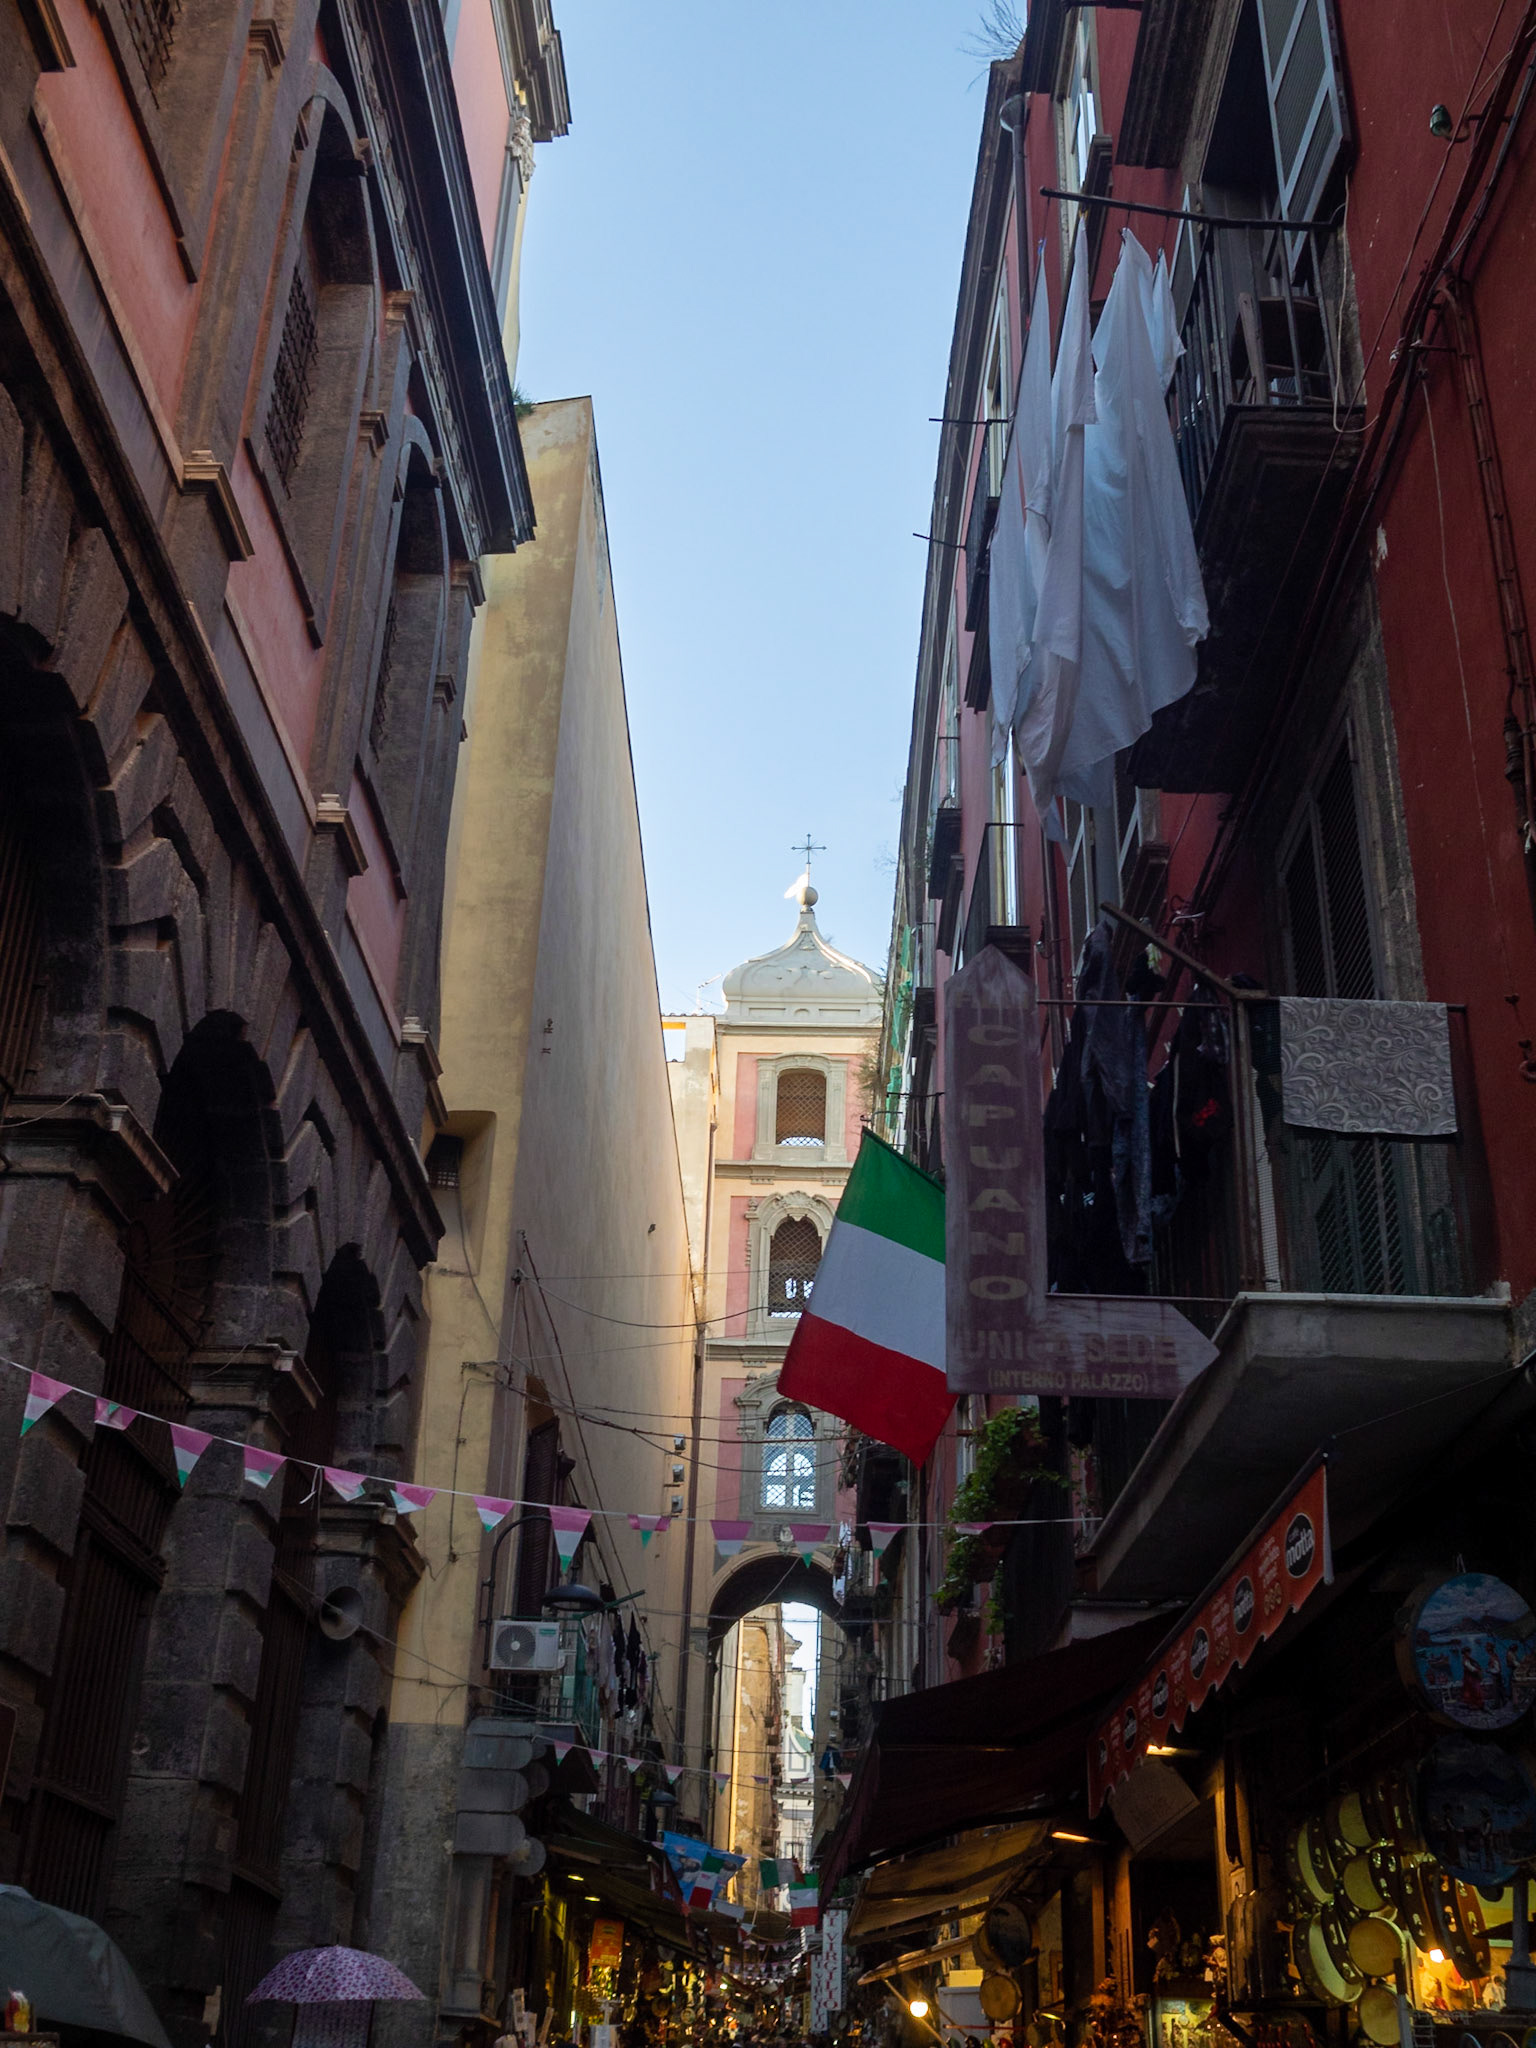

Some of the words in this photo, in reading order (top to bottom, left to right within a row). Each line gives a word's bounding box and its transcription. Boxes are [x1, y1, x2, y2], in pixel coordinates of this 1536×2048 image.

[966, 1025, 1029, 1300] CAPUANO
[1084, 1333, 1177, 1365] SEDE
[1071, 1371, 1149, 1395] PALAZZO)
[1286, 1527, 1314, 1568] motta
[824, 1932, 839, 2009] VIRGILIO
